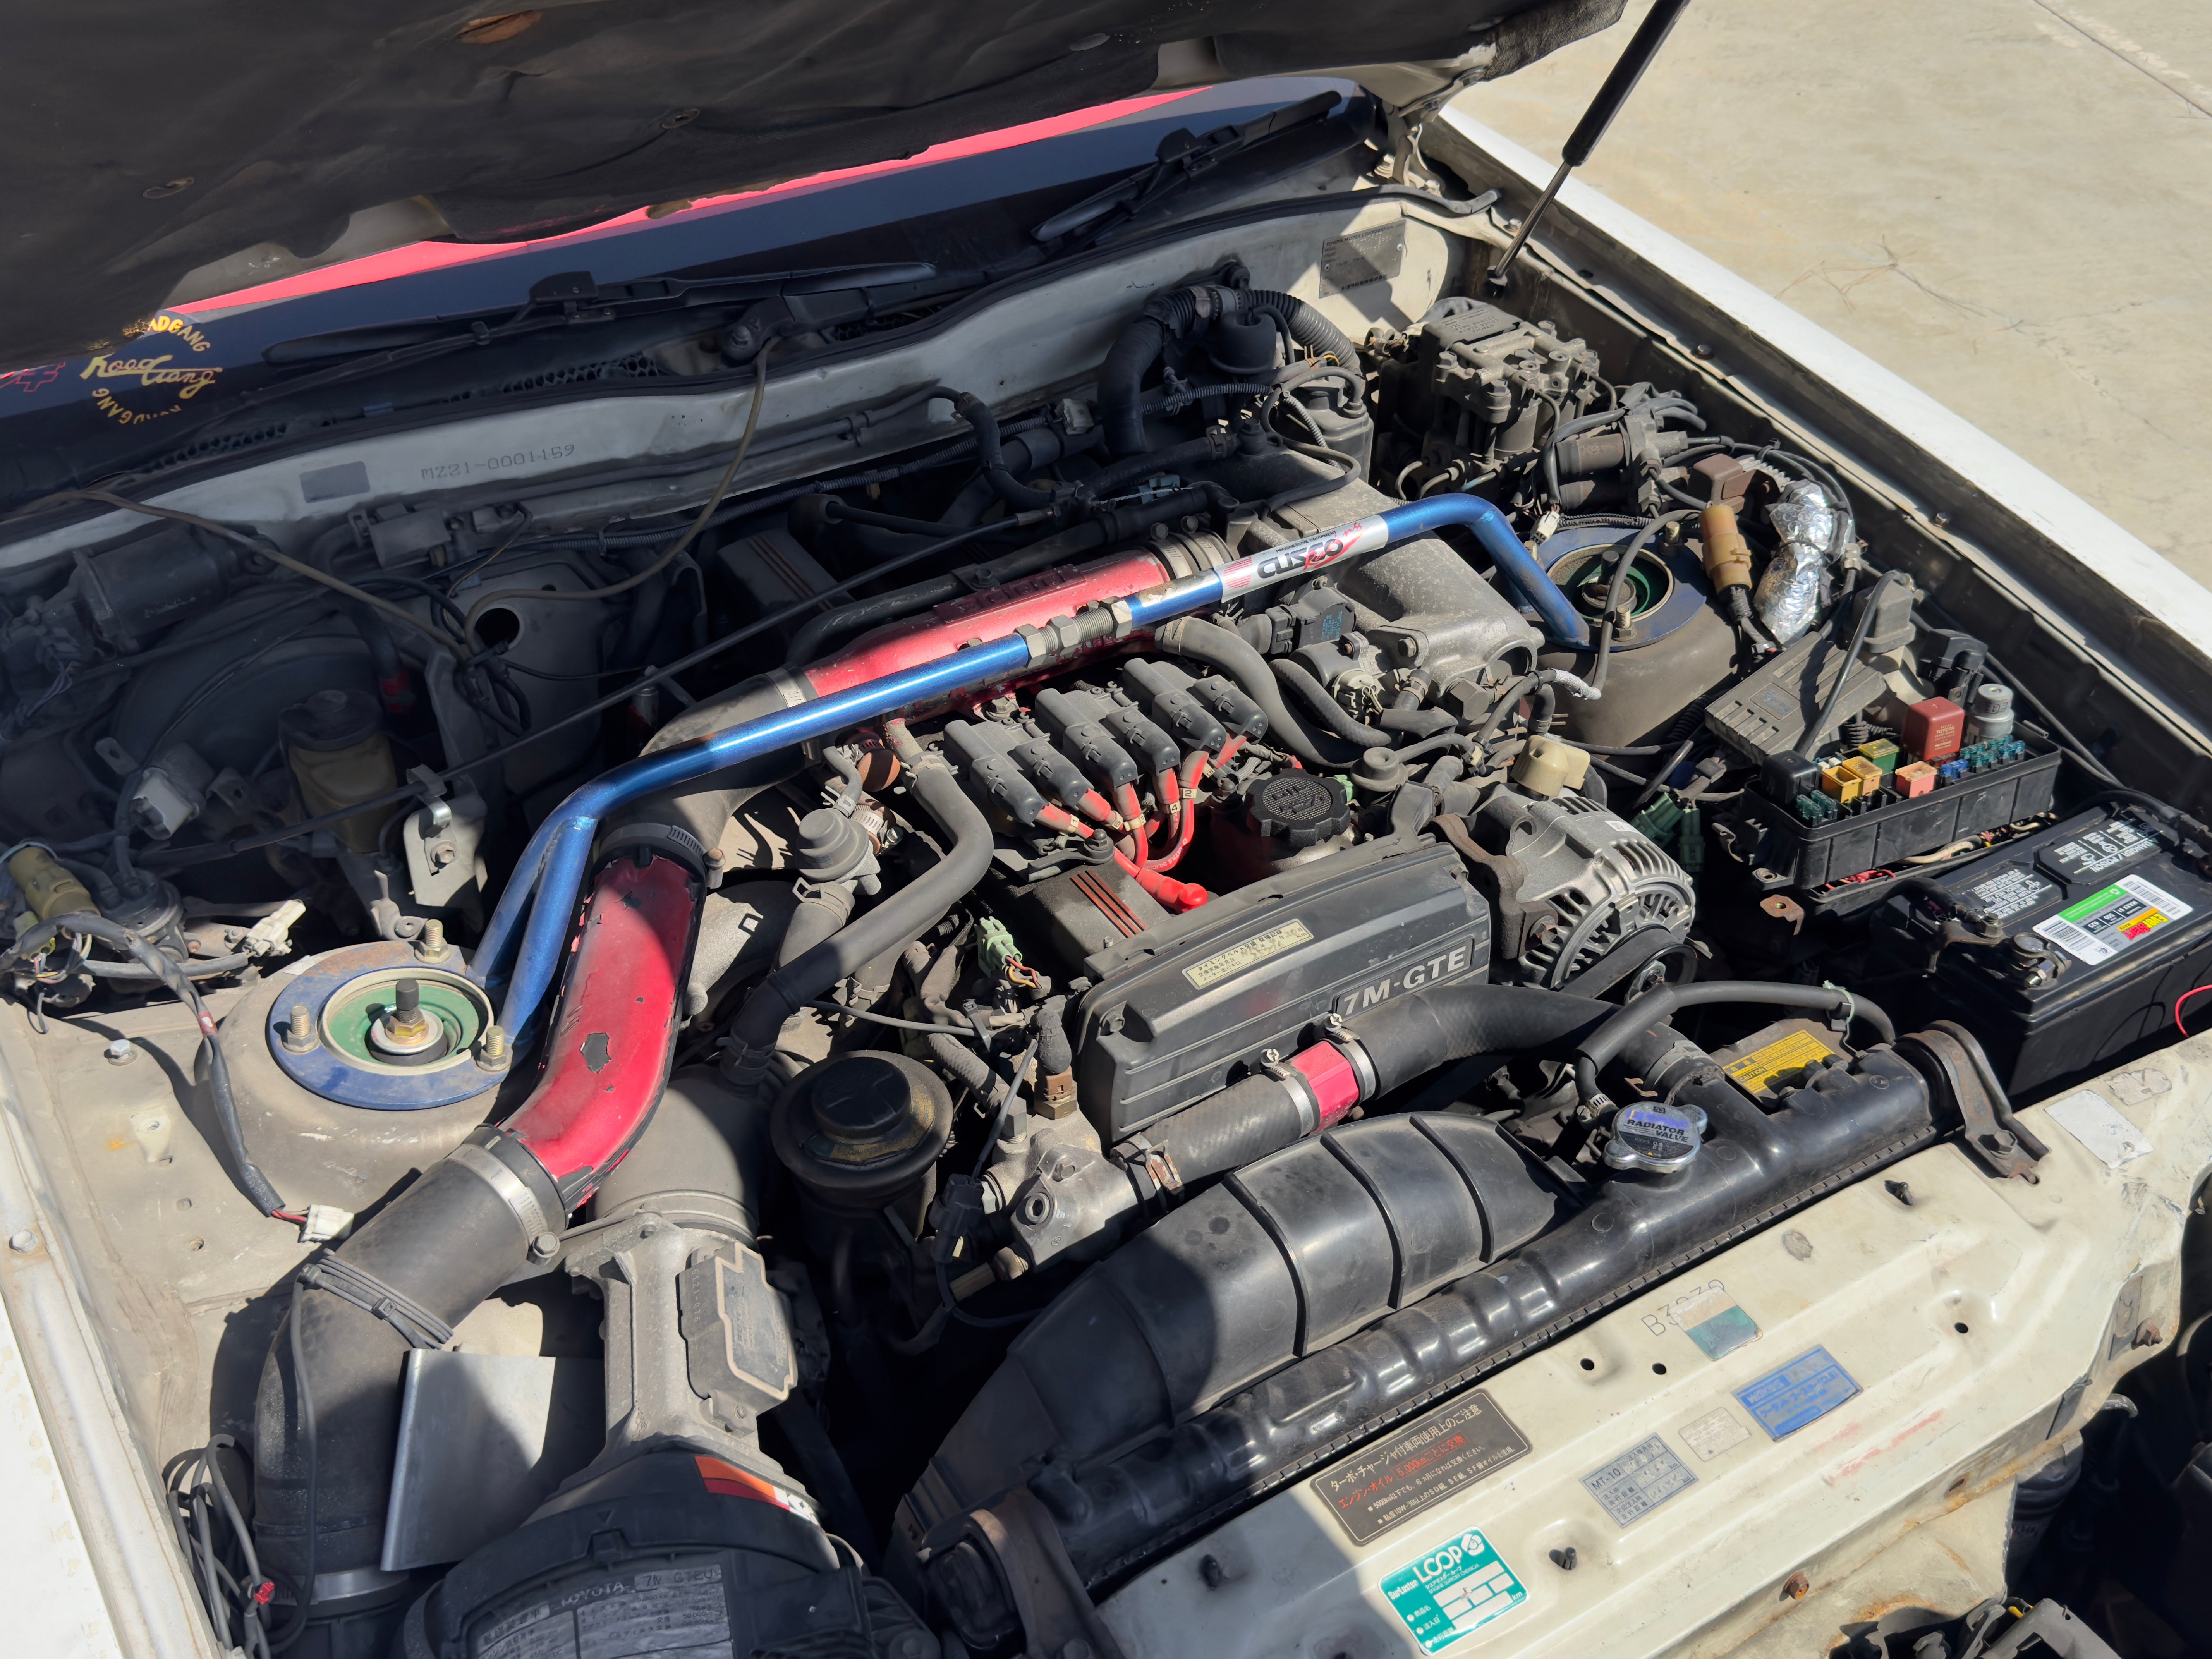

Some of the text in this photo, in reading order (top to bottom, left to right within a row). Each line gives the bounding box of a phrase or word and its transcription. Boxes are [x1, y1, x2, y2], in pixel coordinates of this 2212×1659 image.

[1276, 531, 1336, 553] PROGRESSIVE EQUIPMENT
[1257, 539, 1343, 579] CUSCO
[2121, 840, 2152, 858] DANGER
[2088, 856, 2118, 872] POISON
[2122, 912, 2169, 941] EverStart
[1343, 945, 1467, 1016] 7M-GTE
[1739, 1046, 1812, 1083] CAUTION KEEP HANDS CLEAR
[1627, 1119, 1685, 1135] RADIATOR
[1656, 1130, 1689, 1142] VALVE
[1626, 1443, 1653, 1461] 注入年月日
[1591, 1468, 1621, 1490] MT-10
[1602, 1488, 1620, 1500] 注入時
[1413, 1544, 1463, 1580] LOOP
[1428, 1562, 1480, 1594] ENGINE SUPPORT CHEMICAL
[1388, 1578, 1419, 1600] SurLuster
[1511, 1590, 1523, 1601] km
[1413, 1604, 1432, 1618] 商品名
[1422, 1616, 1441, 1630] 注入日
